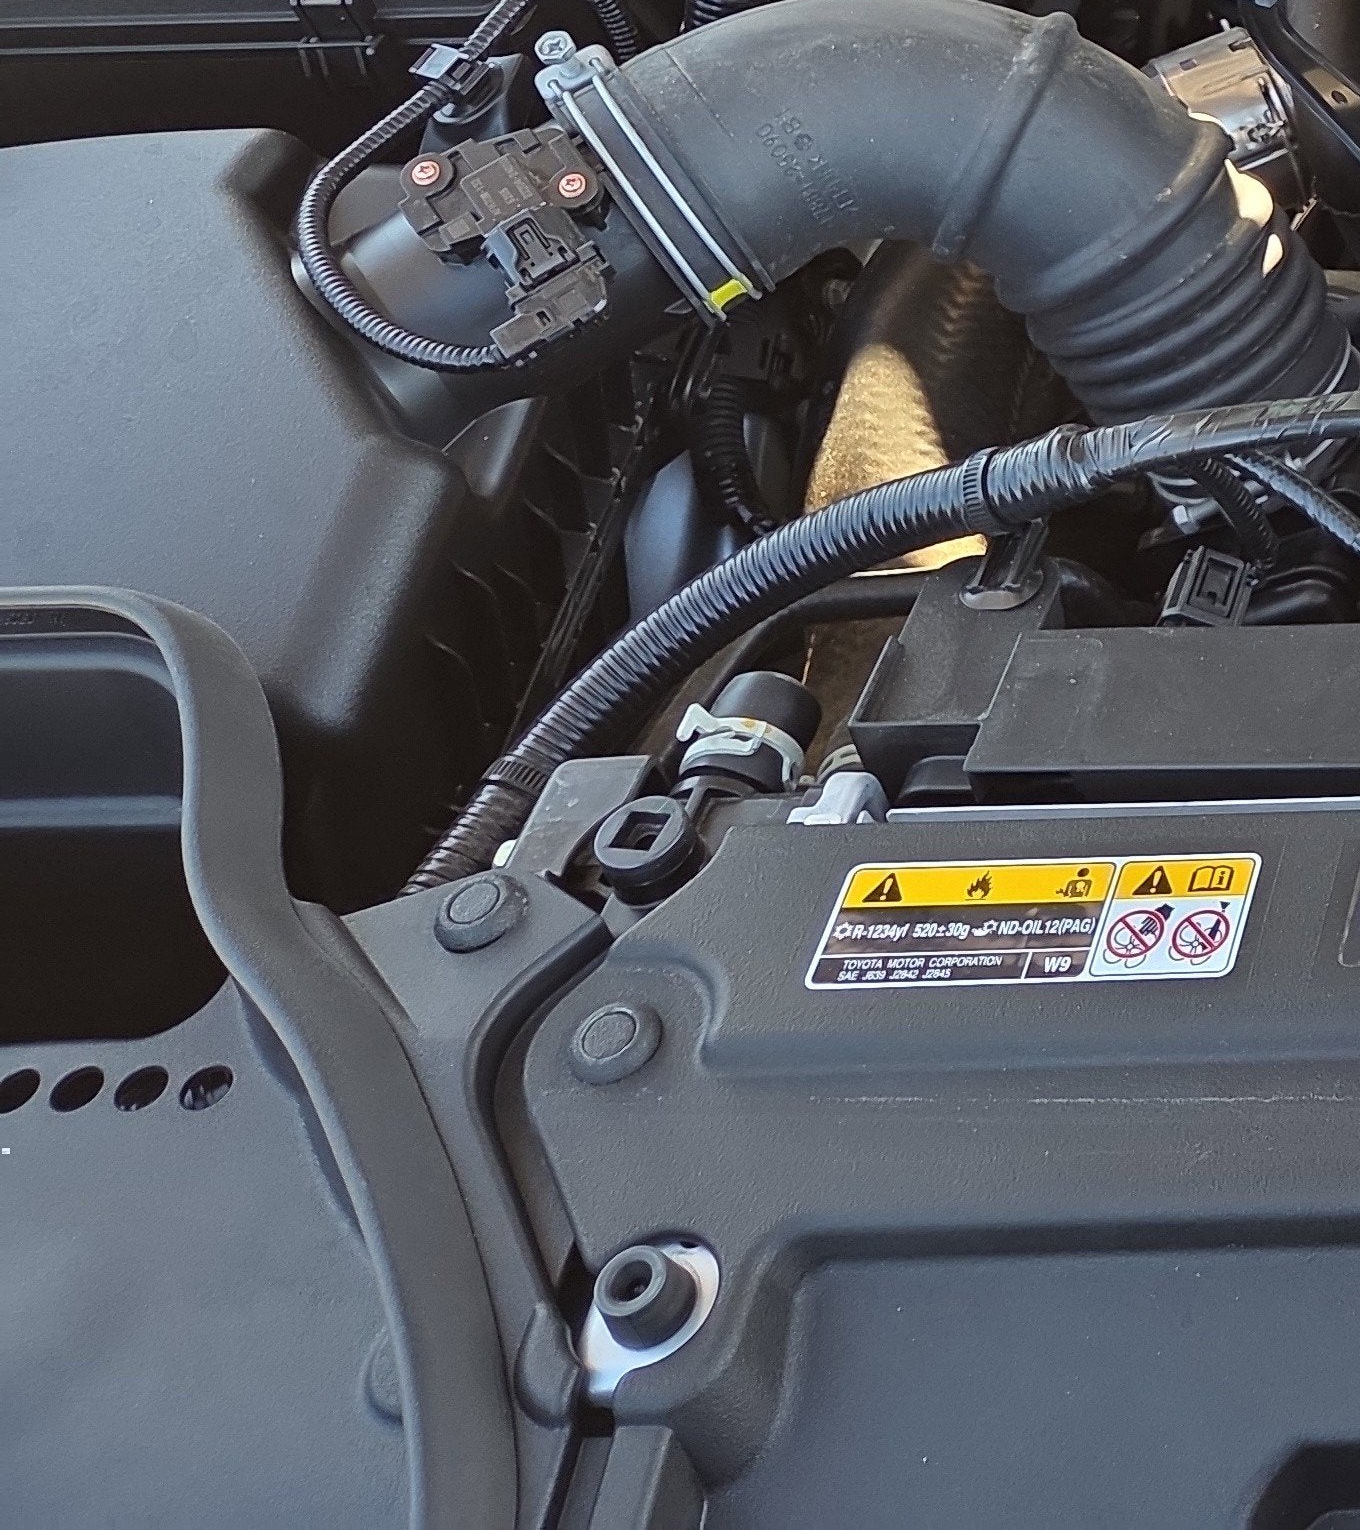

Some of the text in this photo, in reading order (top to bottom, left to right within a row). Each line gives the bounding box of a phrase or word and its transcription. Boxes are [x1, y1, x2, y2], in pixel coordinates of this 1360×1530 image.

[852, 917, 1096, 941] R-1234yf 520±30g ND-OIL12(PAG)
[843, 955, 1003, 970] TOYOTA MOTOR CORPORATION
[1043, 956, 1071, 973] W9
[837, 971, 857, 981] SAE
